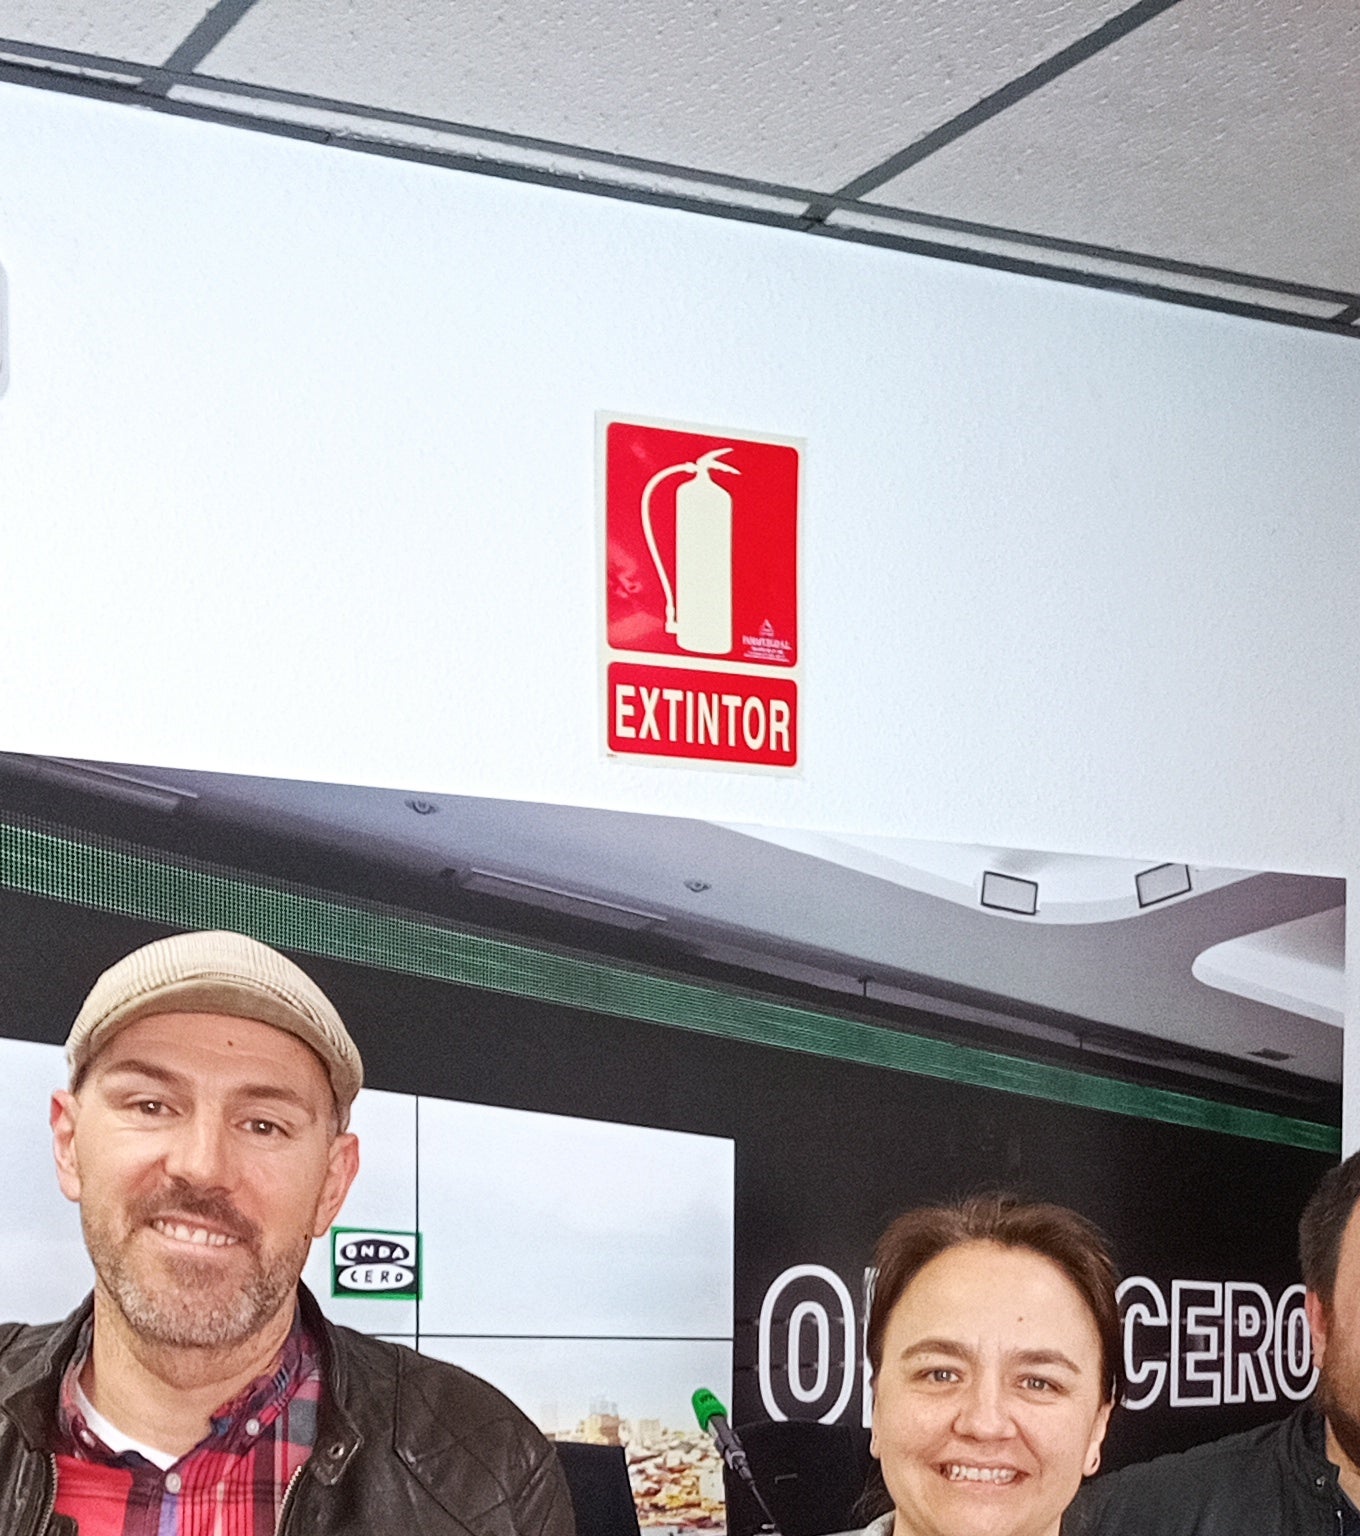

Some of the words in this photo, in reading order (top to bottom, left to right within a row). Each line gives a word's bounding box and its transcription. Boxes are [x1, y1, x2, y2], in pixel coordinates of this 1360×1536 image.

[615, 684, 791, 752] EXTINTOR
[345, 1244, 405, 1259] ONDA
[350, 1270, 403, 1283] CERO
[1116, 1275, 1321, 1410] CERO
